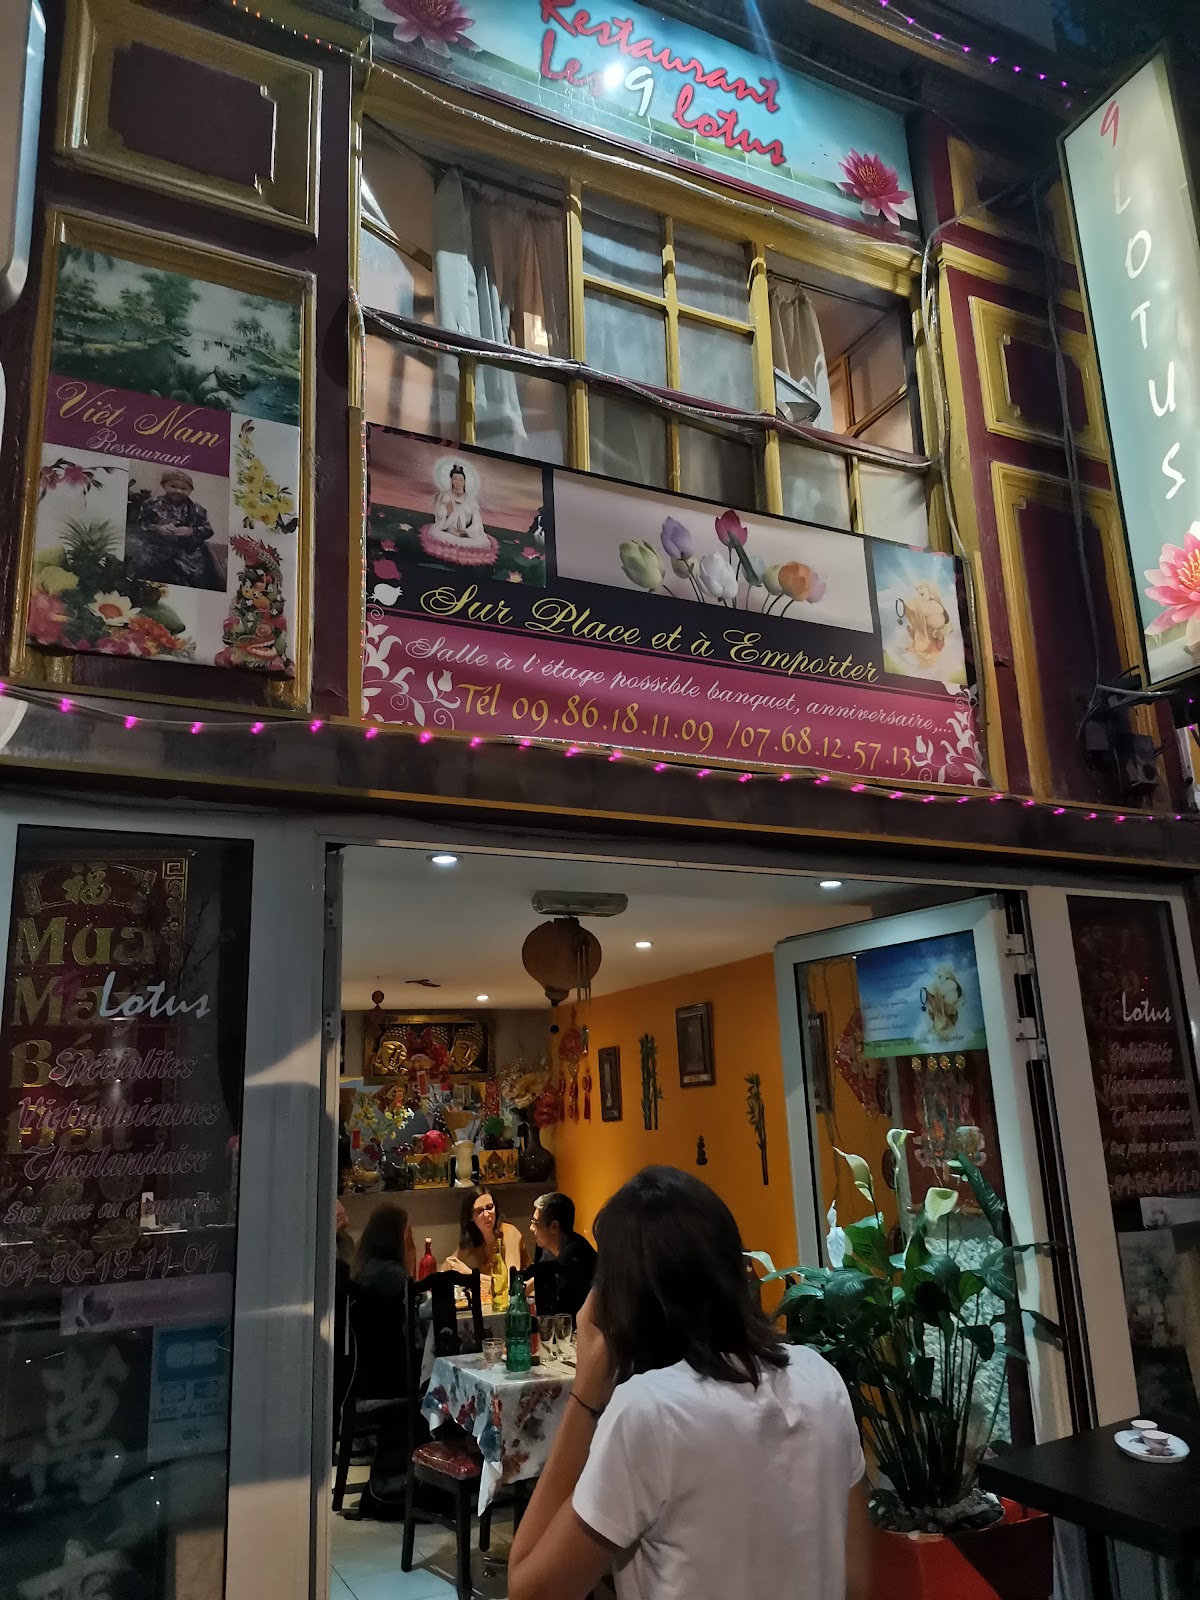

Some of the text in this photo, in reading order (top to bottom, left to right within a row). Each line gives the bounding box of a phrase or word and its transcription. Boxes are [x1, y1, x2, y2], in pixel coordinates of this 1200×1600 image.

[540, 0, 780, 113] Restaurant
[624, 65, 654, 117] 9
[1100, 99, 1120, 148] 9
[86, 427, 192, 466] Restaurant
[133, 404, 225, 449] Nam
[420, 584, 879, 682] Sur Place et à Emporter
[405, 636, 489, 667] Salle
[495, 652, 514, 671] à
[522, 653, 605, 687] l'étage
[610, 671, 701, 698] possible
[706, 680, 801, 715] banquet,
[457, 683, 501, 716] Tél
[511, 694, 714, 752] 09.86.18.11.09
[99, 970, 210, 1019] Lotus
[1122, 992, 1172, 1023] Lotus
